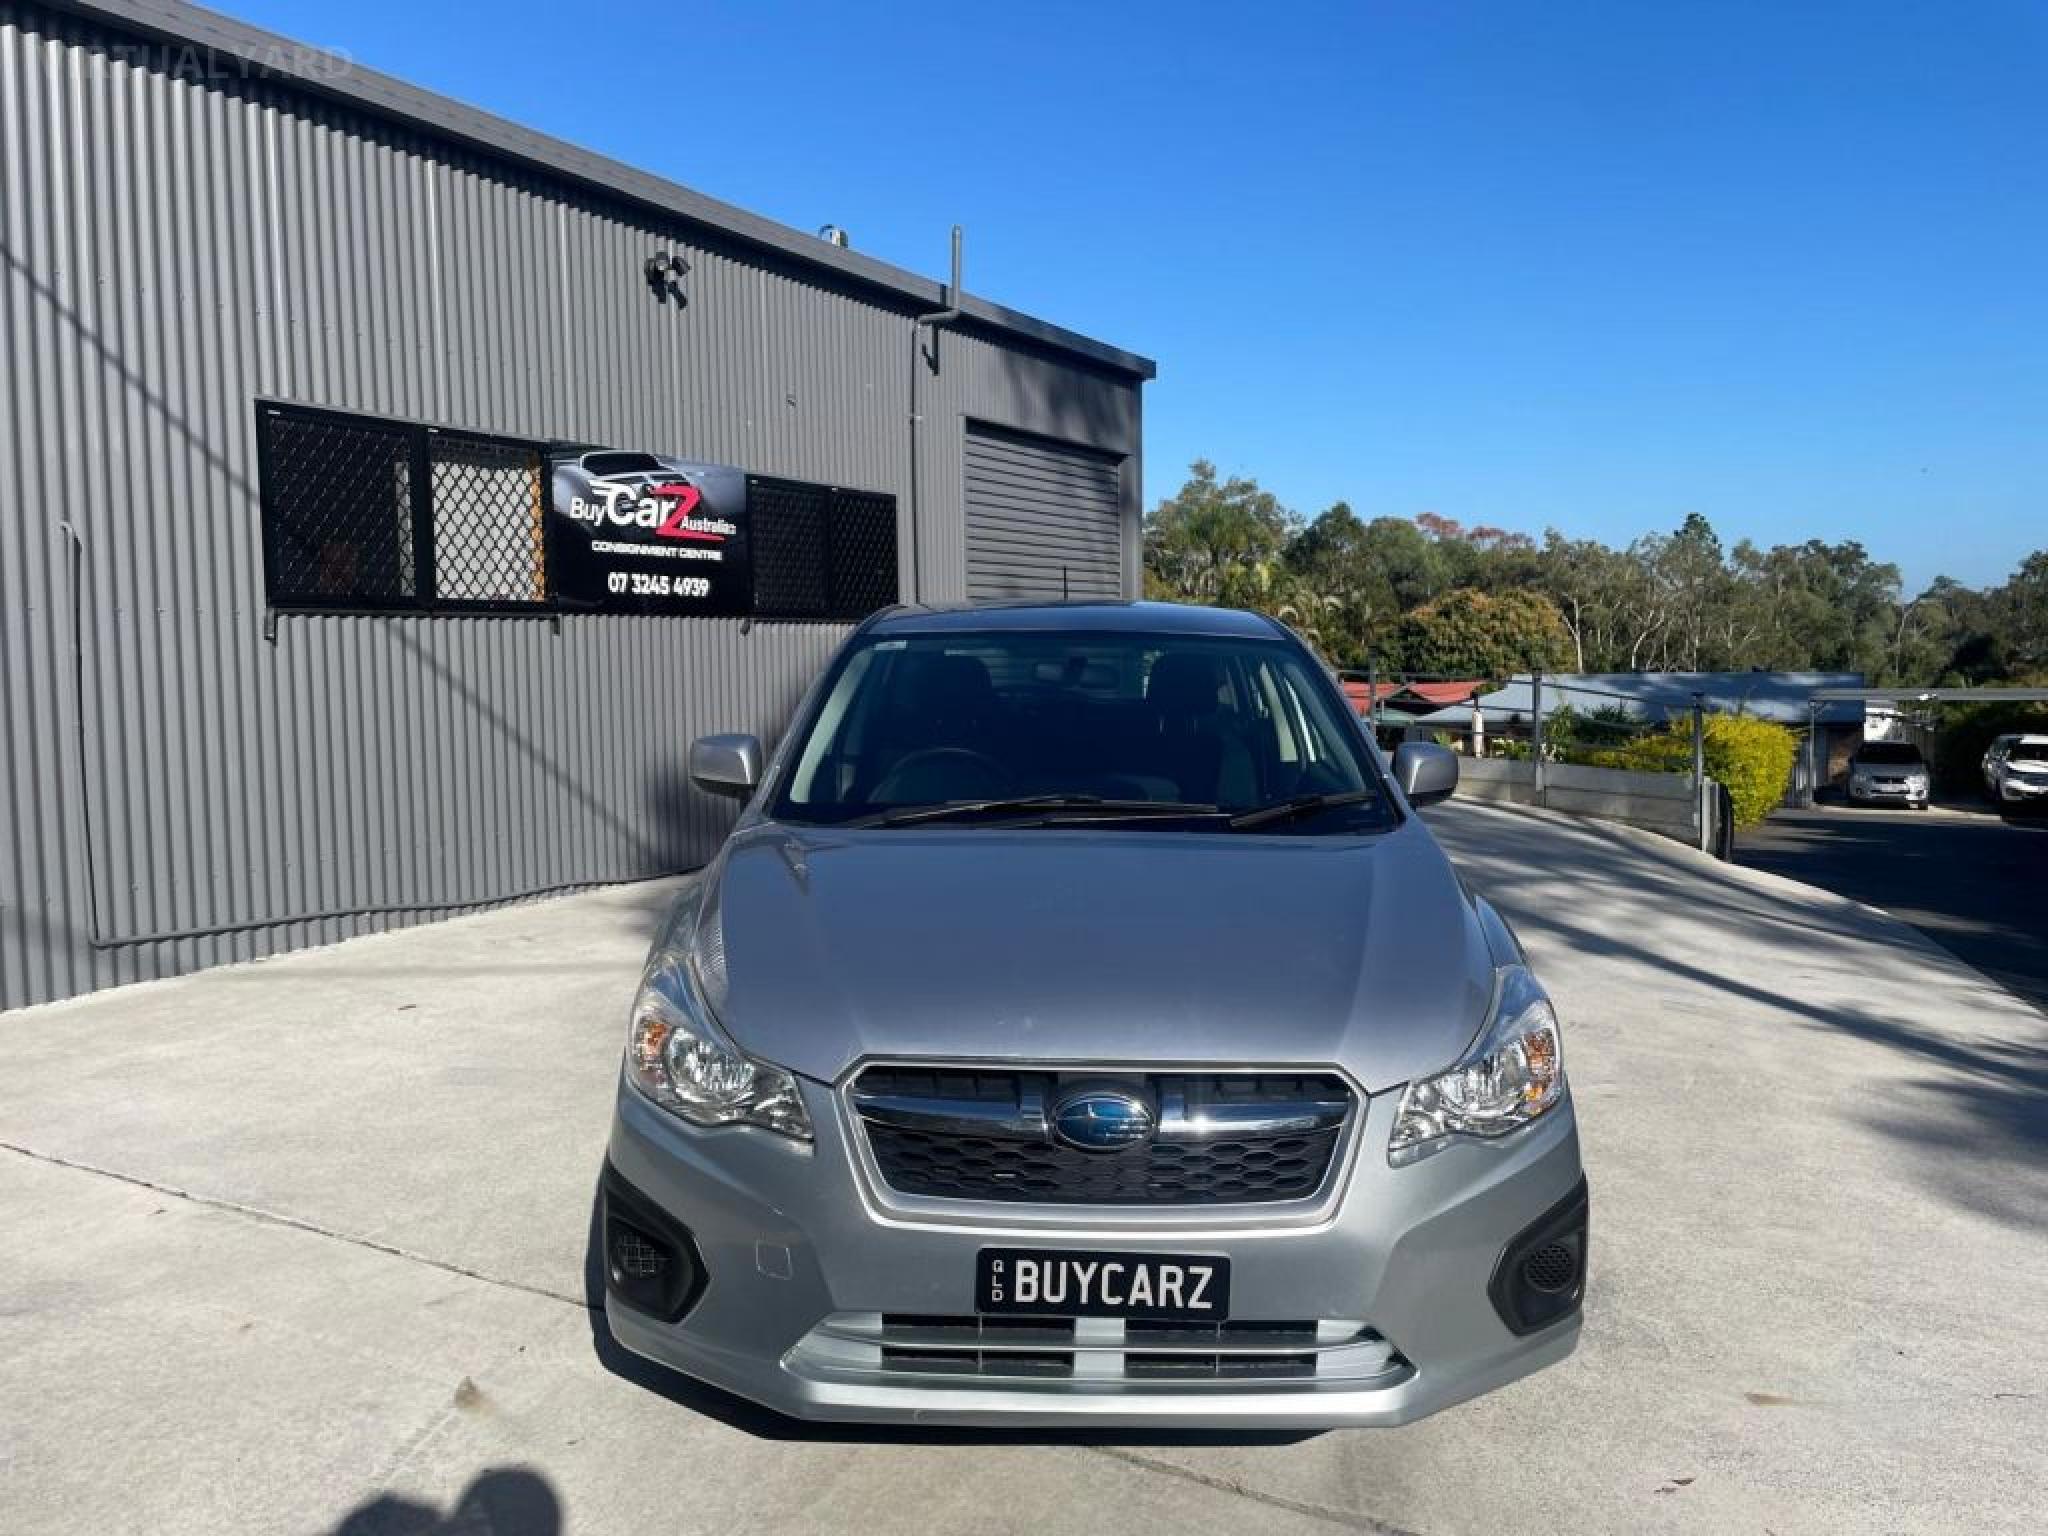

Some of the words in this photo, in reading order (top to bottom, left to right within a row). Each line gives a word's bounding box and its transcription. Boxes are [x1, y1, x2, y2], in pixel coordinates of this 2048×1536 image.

[680, 515, 737, 535] Australia
[607, 571, 628, 593] 07
[630, 574, 670, 595] 3245
[673, 577, 710, 598] 4939
[991, 1259, 1005, 1303] QLD
[1015, 1259, 1213, 1310] BUYCARZ
